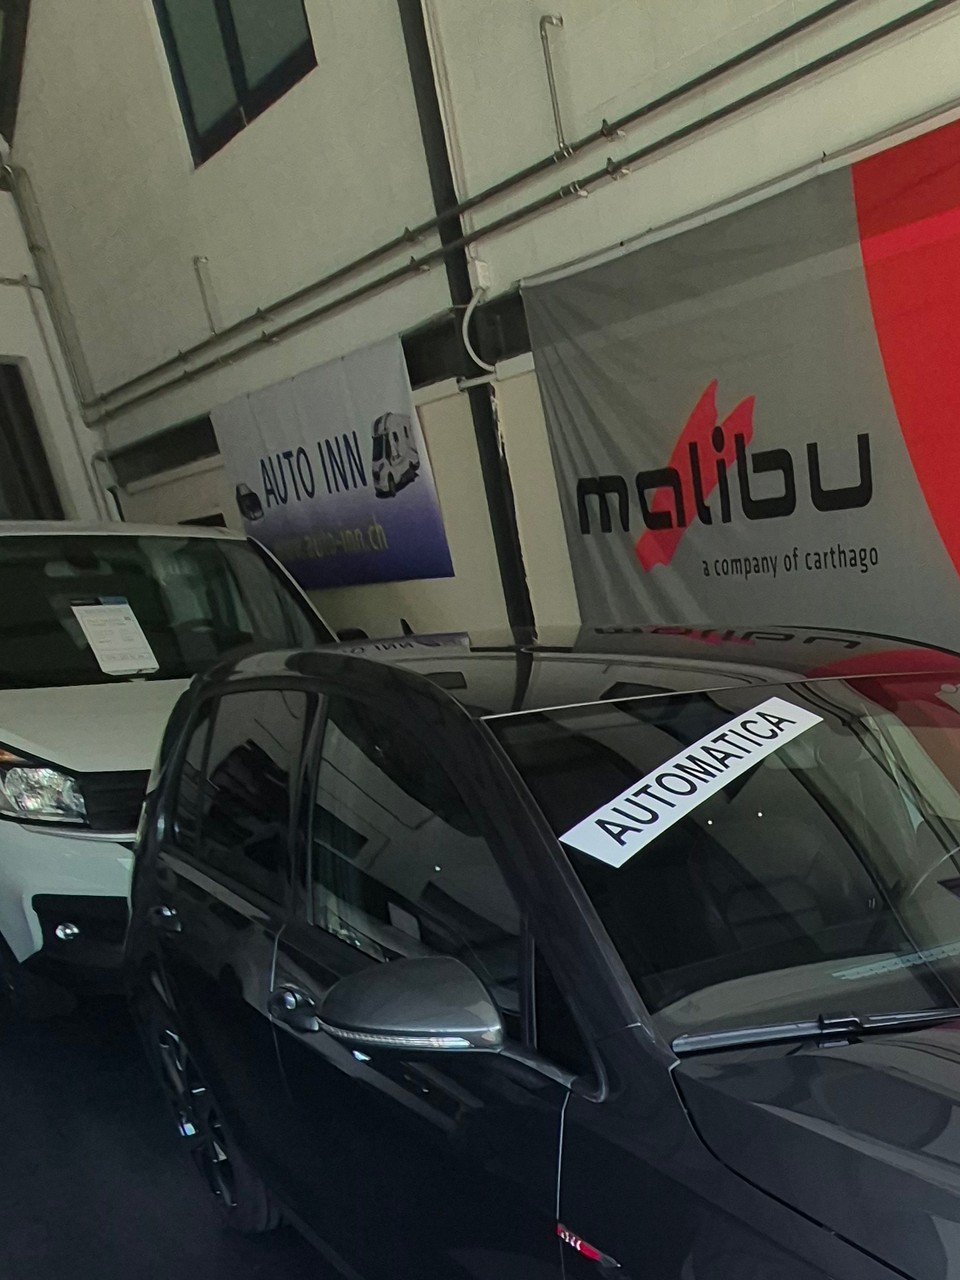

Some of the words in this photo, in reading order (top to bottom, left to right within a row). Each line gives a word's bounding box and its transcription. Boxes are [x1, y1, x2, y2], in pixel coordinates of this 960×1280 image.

[260, 446, 316, 508] AUTO
[317, 430, 369, 495] INN
[576, 425, 873, 535] malibu
[702, 558, 710, 577] a
[714, 554, 778, 580] company
[784, 546, 799, 573] of
[805, 543, 879, 574] carthago
[594, 711, 796, 847] AUTOMATICA
